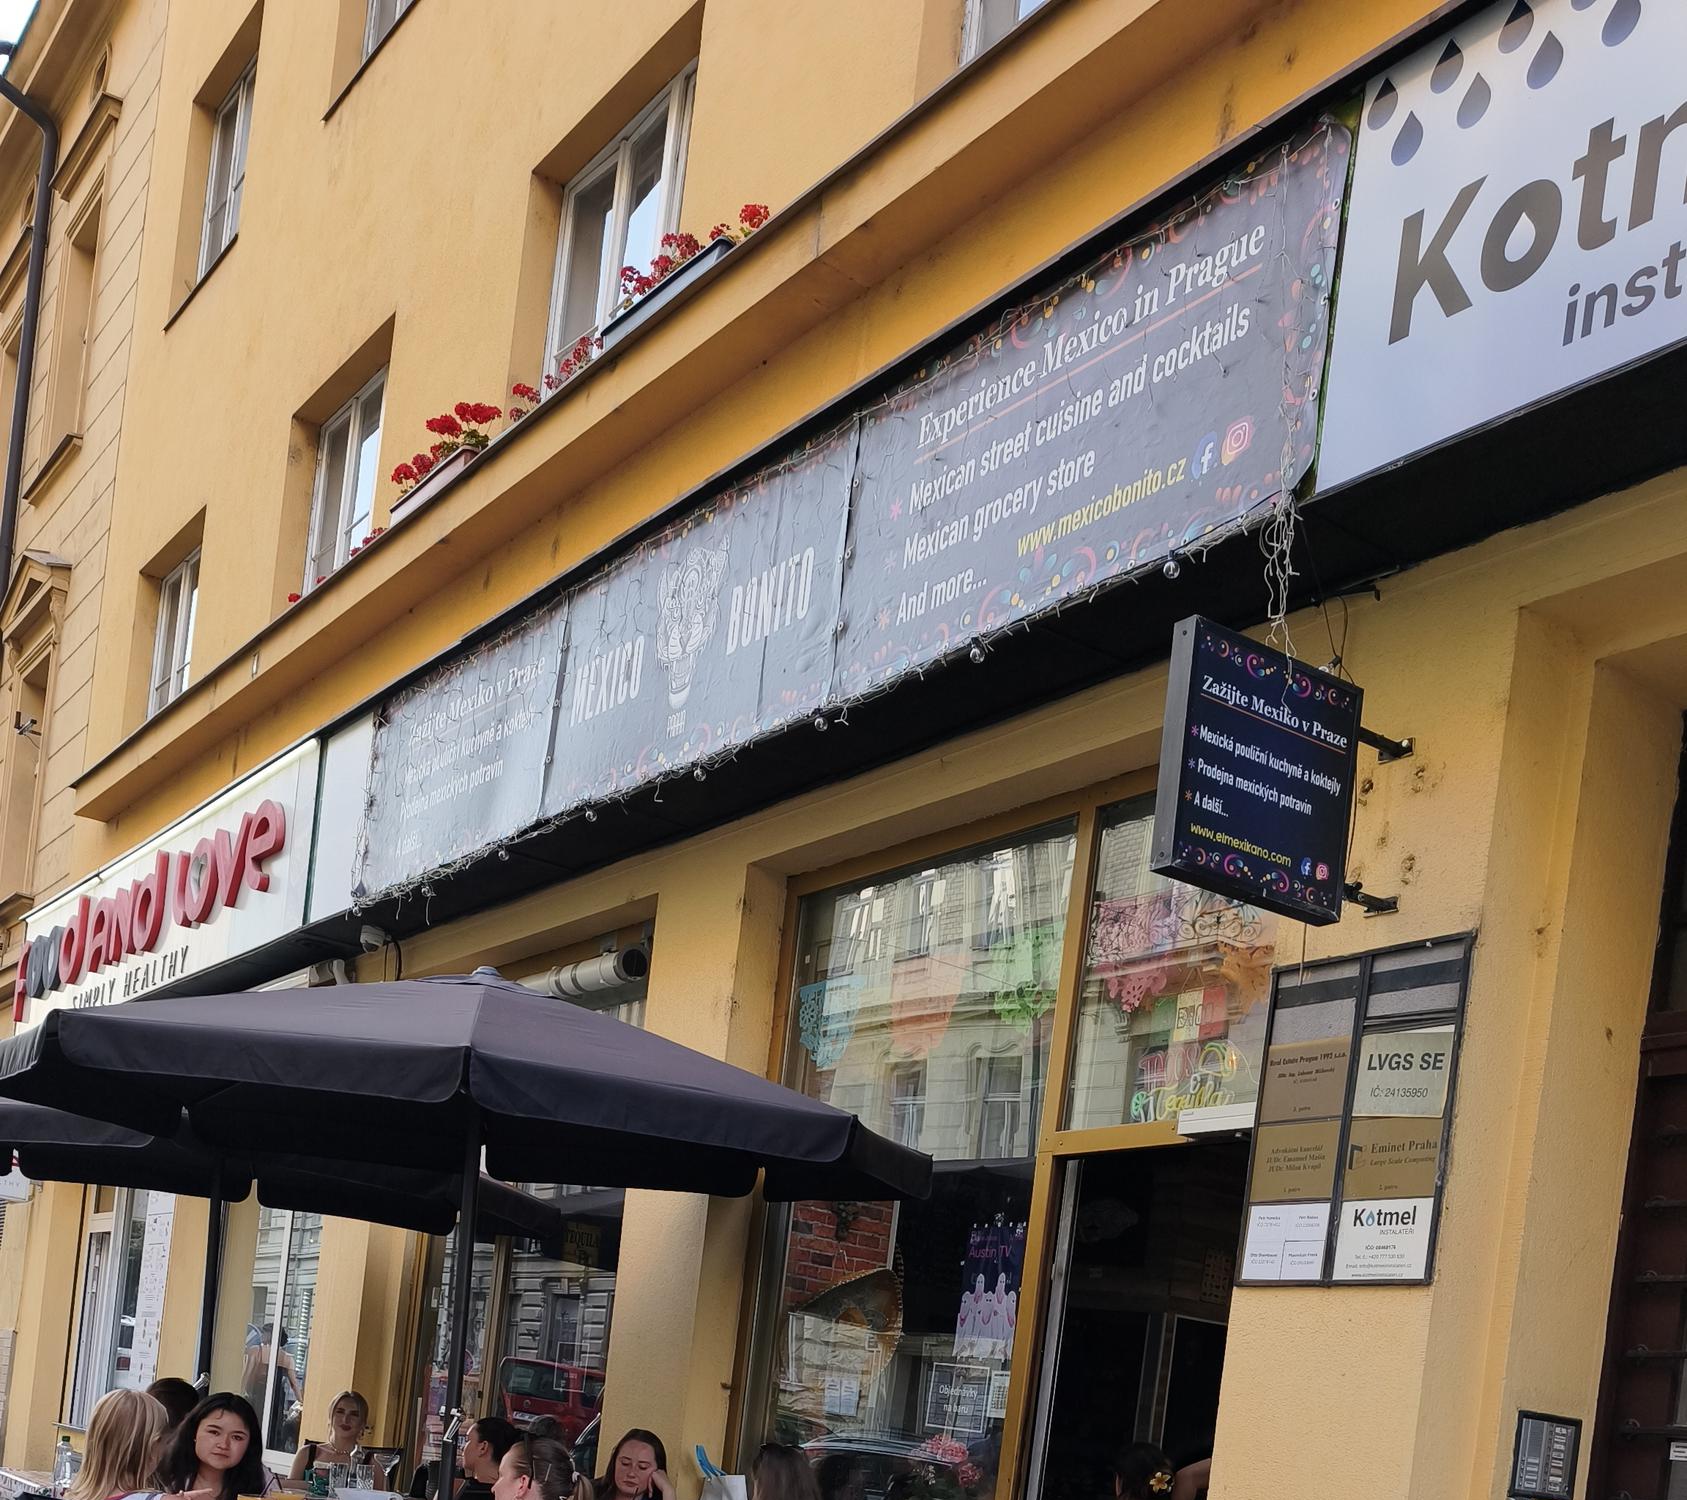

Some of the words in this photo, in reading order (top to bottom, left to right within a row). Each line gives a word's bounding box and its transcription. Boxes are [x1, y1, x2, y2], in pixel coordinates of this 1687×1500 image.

[916, 360, 1036, 450] Experience
[1040, 307, 1127, 379] Mexico
[1132, 284, 1159, 325] in
[1165, 225, 1265, 306] Prague
[908, 458, 976, 516] Mexican
[980, 421, 1032, 477] street
[1036, 387, 1103, 447] cuisine
[1108, 353, 1147, 408] and
[1152, 302, 1250, 384] cocktails
[903, 512, 969, 570] Mexican
[973, 475, 1043, 543] grocery
[1047, 450, 1095, 497] store
[1017, 457, 1187, 558] www.mexicobonito.cz
[726, 547, 814, 656] BONITO
[895, 584, 931, 627] And
[931, 567, 987, 610] more...
[1202, 675, 1249, 706] Zažijte
[1251, 695, 1299, 729] Mexiko
[1301, 720, 1310, 733] v
[1312, 720, 1348, 749] Praze
[470, 756, 503, 793] potravin
[1197, 758, 1234, 786] Prodejna
[1235, 776, 1279, 803] mexických
[1279, 793, 1312, 816] potravin
[1200, 724, 1234, 752] Mexická
[1234, 742, 1269, 766] pouliční
[1268, 752, 1302, 779] kuchyně
[1303, 770, 1310, 782] a
[1311, 769, 1341, 797] koktejly
[1194, 791, 1200, 807] A
[1190, 823, 1292, 867] www.elmexikano.com
[123, 945, 189, 998] HEALTHY
[1367, 1052, 1414, 1071] LVGS
[1420, 1052, 1445, 1071] SE
[1384, 1087, 1428, 1098] 24135950
[1408, 1139, 1438, 1152] Praha
[969, 1246, 997, 1258] Austin
[999, 1244, 1012, 1258] TV
